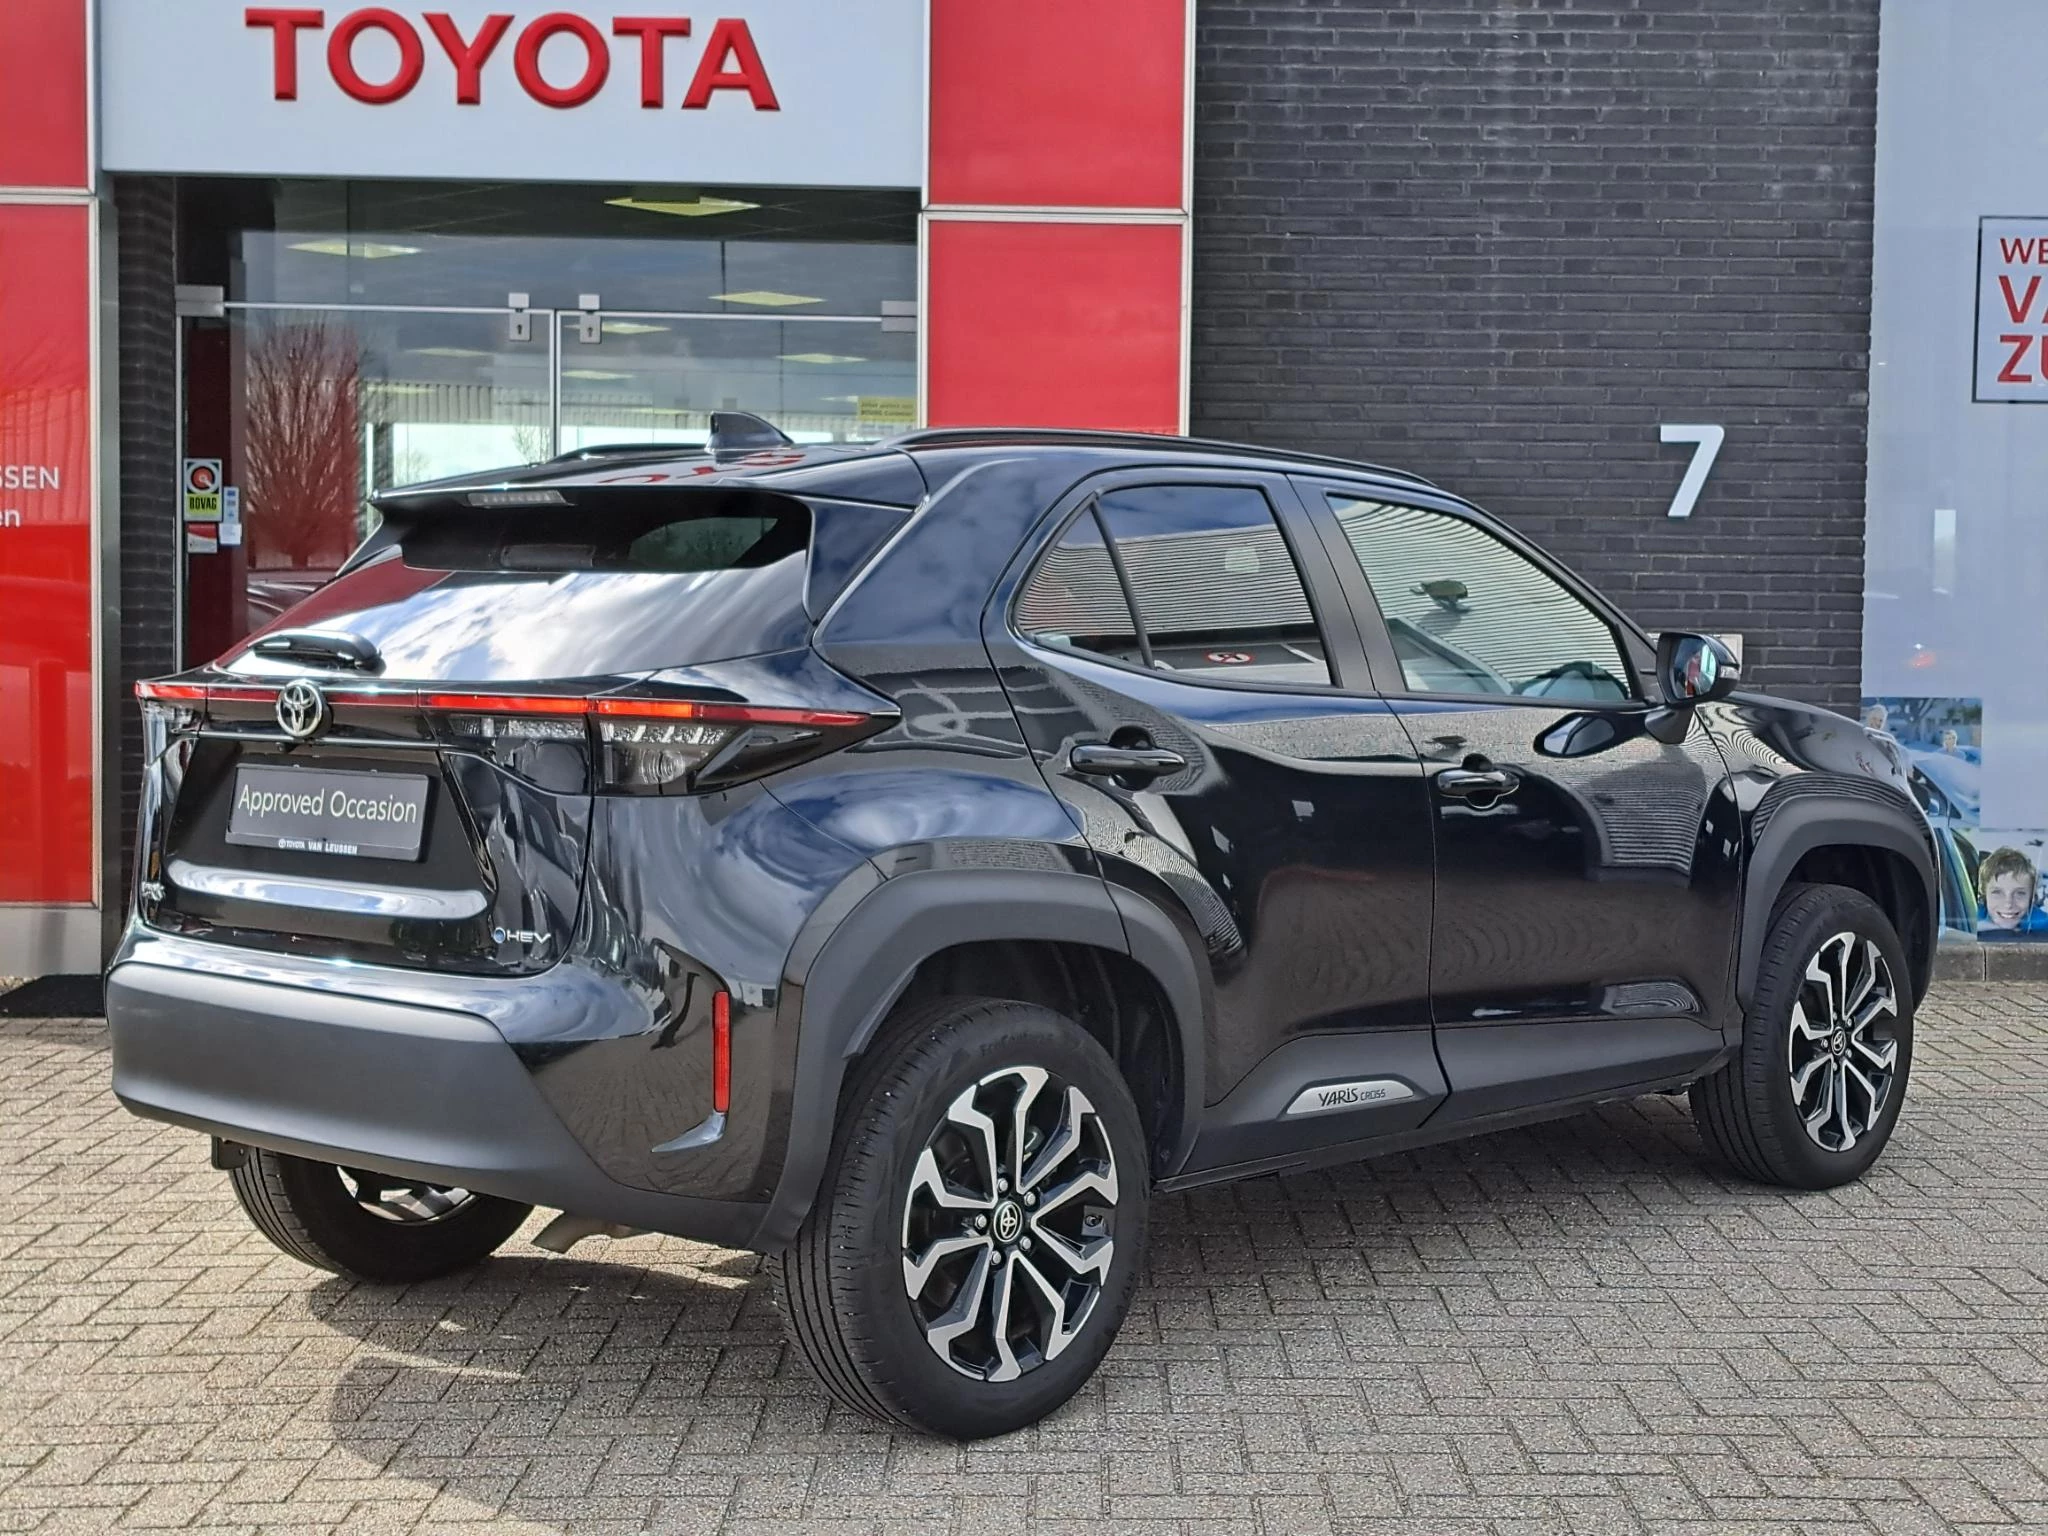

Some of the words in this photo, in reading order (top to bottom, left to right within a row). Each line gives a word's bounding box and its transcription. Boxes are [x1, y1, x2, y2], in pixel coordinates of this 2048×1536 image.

[245, 7, 781, 111] TOYOTA
[1998, 275, 2048, 324] V
[1996, 334, 2048, 383] Z
[0, 465, 59, 490] SEN
[1660, 424, 1724, 517] 7
[189, 496, 217, 511] BOVAG
[238, 784, 325, 817] Approved
[330, 790, 417, 823] Occasion
[308, 841, 322, 851] VAN
[325, 843, 358, 855] LEUSSEN
[506, 930, 552, 944] HEV
[1360, 1088, 1386, 1101] CROSS
